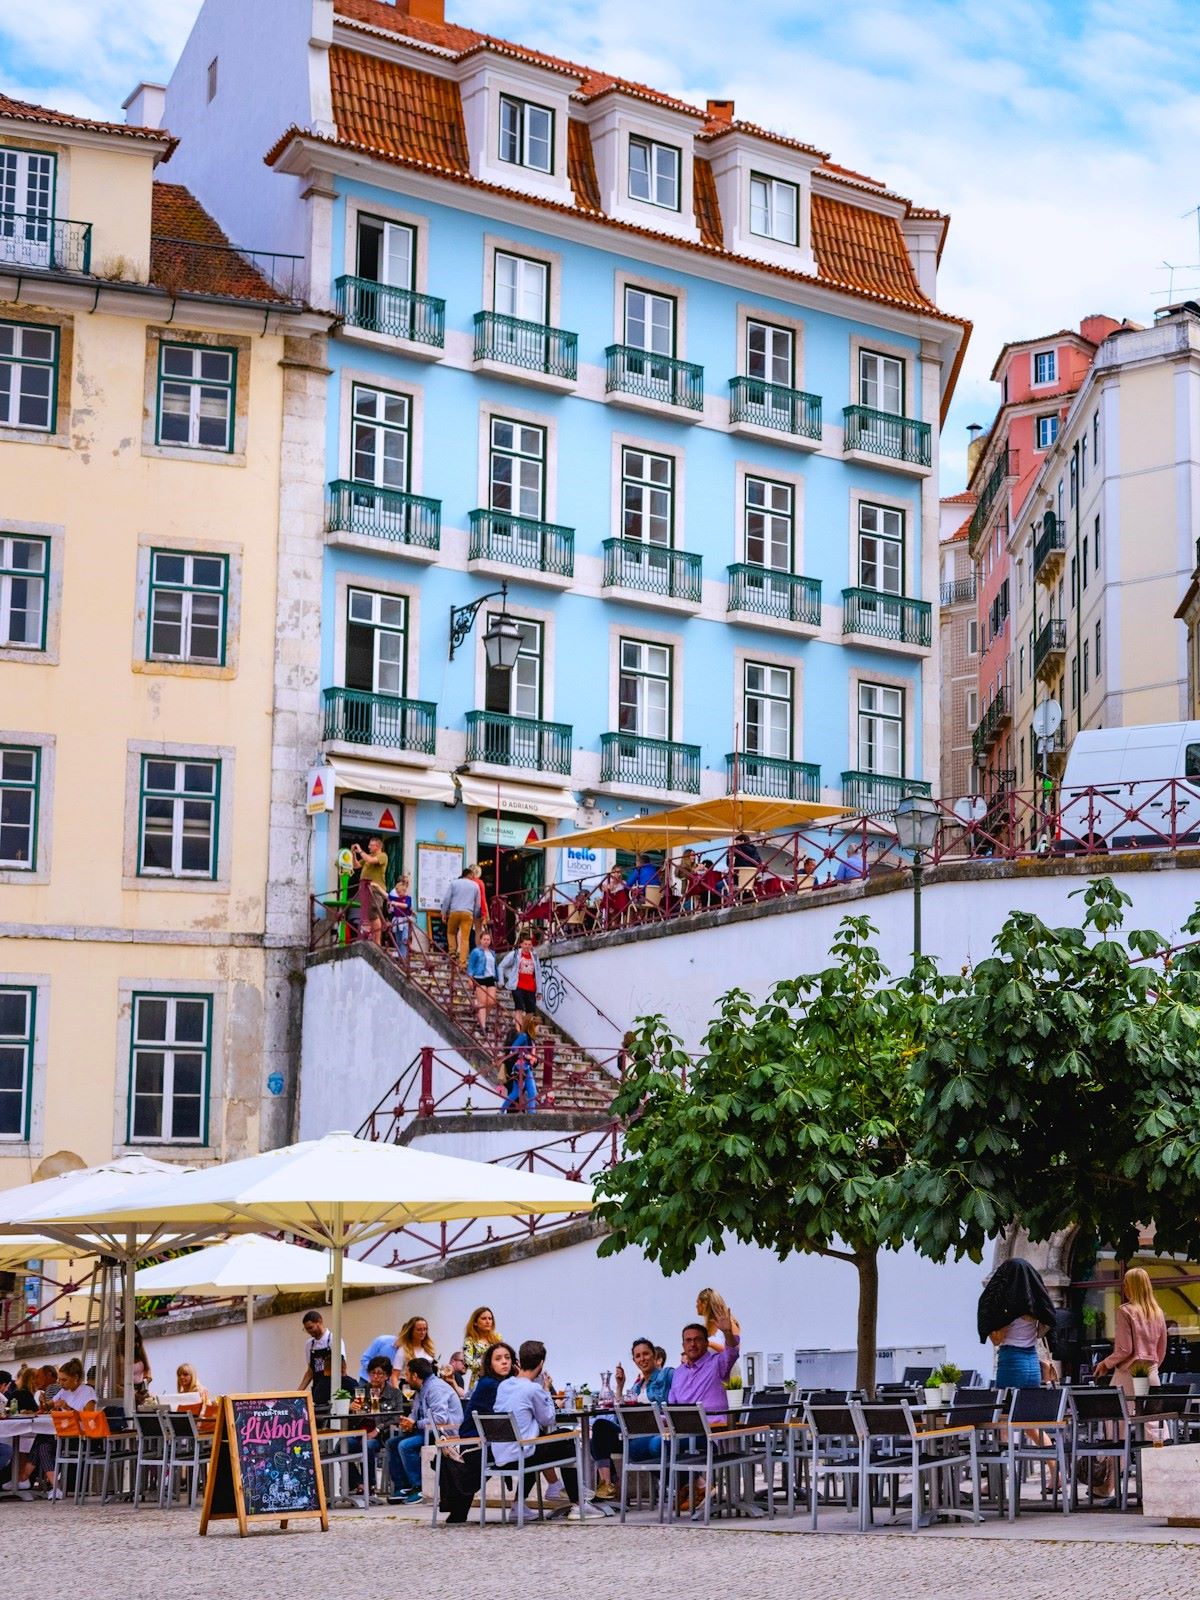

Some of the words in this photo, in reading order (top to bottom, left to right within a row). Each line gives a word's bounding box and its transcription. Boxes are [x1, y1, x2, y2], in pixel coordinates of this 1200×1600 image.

[509, 801, 539, 812] ADRIANO
[567, 848, 596, 862] hello
[567, 860, 592, 871] Lisbon
[241, 1416, 311, 1447] Lisbon
